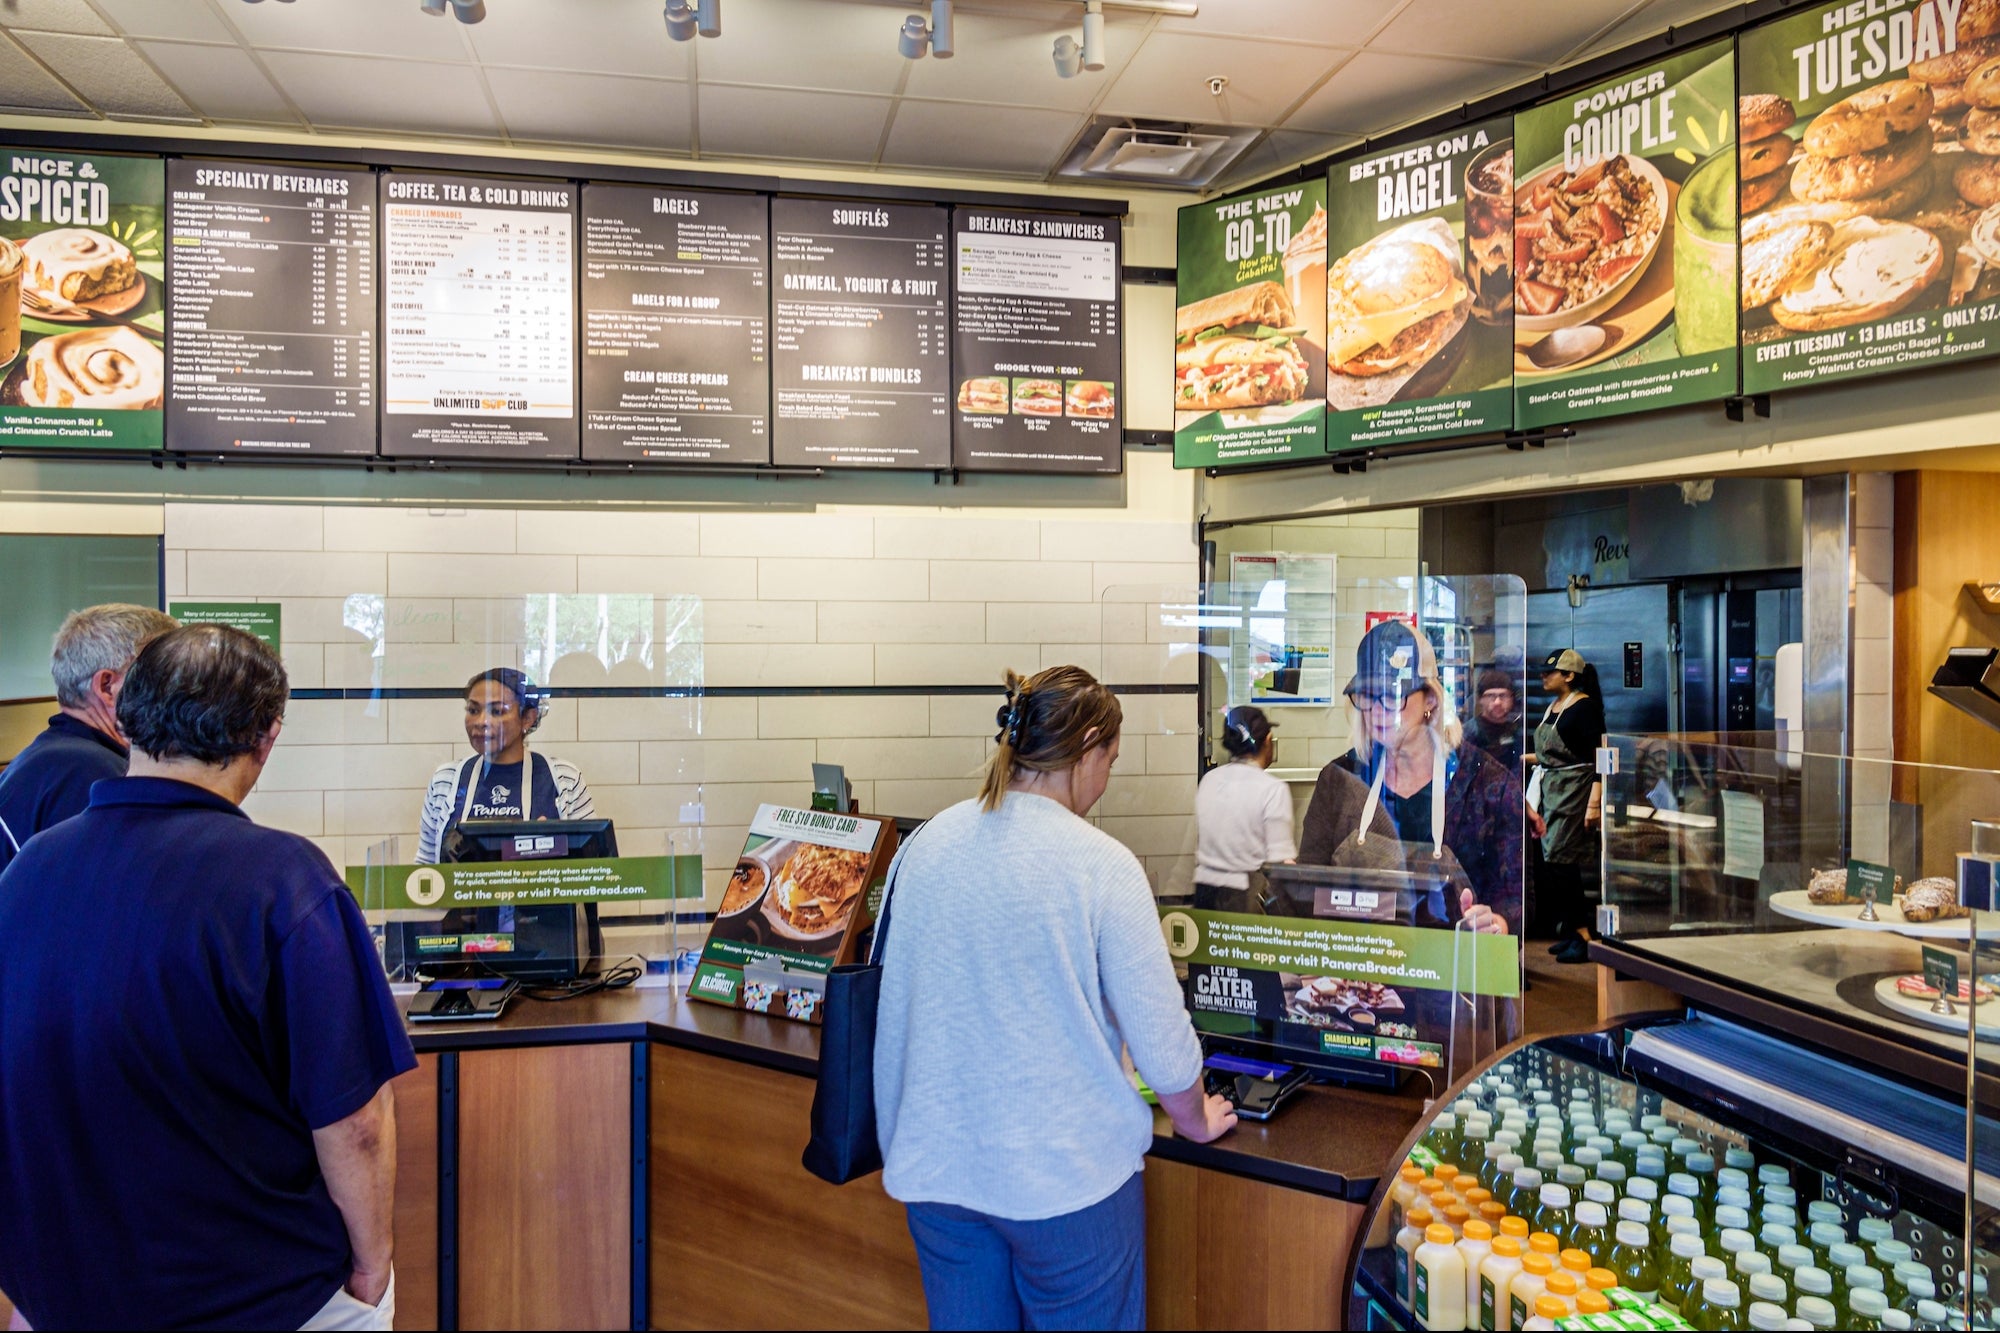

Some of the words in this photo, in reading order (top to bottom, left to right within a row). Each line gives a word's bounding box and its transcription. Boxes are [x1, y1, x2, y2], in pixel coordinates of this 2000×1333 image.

[1792, 0, 1962, 102] TUESDAY
[1573, 70, 1666, 120] POWER
[1564, 88, 1677, 173] COUPLE
[12, 156, 74, 177] NICE
[78, 161, 99, 179] &
[1348, 144, 1432, 183] BETTER
[1436, 134, 1468, 158] ON
[1471, 129, 1490, 150] A
[196, 168, 271, 190] SPECIALTY
[272, 172, 349, 197] BEVERAGES
[1377, 160, 1457, 223] BAGEL
[0, 175, 109, 226] SPICED
[388, 182, 440, 201] COFFEE,
[443, 184, 468, 202] TEA
[469, 187, 483, 203] &
[485, 188, 519, 206] COLD
[521, 190, 570, 209] DRINKS
[653, 197, 700, 216] BAGELS
[1215, 199, 1253, 222] THE
[1256, 189, 1304, 213] NEW
[832, 207, 889, 228] SOUFFLÉS
[968, 215, 1030, 235] BREAKFAST
[1032, 220, 1105, 240] SANDWICHES
[1225, 210, 1291, 263] GO-TO
[1236, 257, 1278, 282] Ciabatta!
[1239, 256, 1258, 271] Now
[1260, 254, 1272, 264] on
[783, 273, 842, 294] OATMEAL,
[844, 276, 889, 294] YOGURT
[891, 279, 903, 295] &
[905, 279, 938, 296] FRUIT
[632, 293, 665, 307] BAGELS
[666, 295, 683, 308] FOR
[684, 296, 691, 308] A
[691, 296, 720, 309] GROUP
[173, 312, 205, 320] Espresso
[1756, 342, 1791, 363] EVERY
[1793, 331, 1847, 355] TUESDAY
[1858, 327, 1874, 344] 13
[1876, 316, 1926, 341] BAGELS
[1942, 307, 1977, 329] ONLY
[1979, 303, 2000, 322] $7.
[1782, 369, 1816, 382] Honey
[1818, 361, 1855, 376] Walnut
[1856, 356, 1894, 370] Cream
[1896, 348, 1940, 362] Cheese
[1942, 338, 1986, 356] Spread
[1808, 349, 1863, 366] Cinnamon
[1865, 341, 1907, 357] Crunch
[1909, 334, 1941, 351] Bagel
[624, 370, 655, 383] CREAM
[656, 371, 689, 384] CHEESE
[689, 372, 729, 386] SPREADS
[802, 364, 868, 382] BREAKFAST
[869, 367, 922, 384] BUNDLES
[994, 362, 1030, 372] CHOOSE
[1030, 364, 1055, 374] YOUR
[1060, 365, 1079, 375] EGG
[1529, 389, 1567, 405] Steel-Cut
[1568, 383, 1603, 398] Oatmeal
[1604, 381, 1620, 392] with
[1621, 373, 1671, 389] Strawberries
[1671, 371, 1679, 380] &
[1679, 365, 1709, 379] Pecans
[1568, 397, 1594, 409] Green
[1595, 391, 1629, 406] Passion
[1630, 384, 1673, 399] Smoothie
[433, 398, 480, 409] UNLIMITED
[507, 400, 529, 411] CLUB
[1361, 410, 1382, 422] NEW!
[1381, 407, 1415, 419] Sausage,
[1415, 402, 1456, 414] Scrambled
[1456, 399, 1472, 410] Egg
[4, 416, 33, 425] Vanilla
[33, 417, 77, 426] Cinnamon
[78, 418, 94, 426] Roll
[1350, 427, 1392, 442] Madagascar
[1393, 425, 1418, 436] Vanilla
[1418, 422, 1443, 433] Cream
[1444, 420, 1463, 430] Cold
[1463, 417, 1484, 428] Brew
[1369, 421, 1376, 429] &
[1376, 417, 1404, 427] Cheese
[1404, 417, 1413, 425] on
[1413, 413, 1437, 424] Asiago
[1436, 411, 1456, 421] Bagel
[14, 427, 57, 436] Cinnamon
[58, 428, 90, 437] Crunch
[91, 429, 114, 438] Latte
[1195, 433, 1212, 444] NEW!
[1211, 433, 1239, 443] Chipotle
[1238, 430, 1267, 441] Chicken,
[1266, 427, 1302, 438] Scrambled
[1302, 424, 1316, 434] Egg
[1224, 440, 1252, 448] Avocado
[1260, 436, 1284, 445] Ciabatta
[1217, 448, 1249, 459] Cinnamon
[1249, 446, 1273, 456] Crunch
[1273, 445, 1292, 453] Latte
[472, 803, 521, 818] Panera
[776, 808, 797, 823] FREE
[794, 810, 811, 826] $10
[809, 812, 837, 830] BONUS
[835, 817, 859, 834] CARD
[454, 890, 474, 900] Get
[474, 889, 492, 899] the
[494, 890, 515, 902] app
[516, 890, 529, 899] or
[529, 887, 551, 897] visit
[553, 884, 647, 897] PaneraBread.com.
[1208, 920, 1230, 931] We're
[1230, 924, 1273, 935] committed
[1274, 926, 1283, 936] to
[1284, 928, 1302, 938] your
[1303, 929, 1330, 942] safety
[1330, 931, 1354, 942] when
[1355, 934, 1396, 948] ordering.
[1208, 930, 1221, 939] For
[1222, 931, 1246, 943] quick,
[1246, 935, 1292, 946] contactless
[1292, 938, 1331, 952] ordering,
[1332, 942, 1369, 954] consider
[1369, 946, 1385, 955] our
[1386, 948, 1408, 960] app.
[1209, 944, 1229, 957] Get
[1231, 946, 1251, 960] the
[1252, 952, 1276, 965] app
[1278, 954, 1293, 965] or
[1293, 953, 1319, 968] visit
[1320, 955, 1441, 981] PaneraBread.com.
[1210, 965, 1226, 977] LET
[1226, 966, 1239, 978] US
[1197, 973, 1254, 1000] CATER
[1193, 993, 1214, 1006] YOUR
[1213, 996, 1234, 1008] NEXT
[1233, 998, 1258, 1010] EVENT
[1324, 1033, 1352, 1045] CHARGED
[1351, 1036, 1372, 1048] UP!
